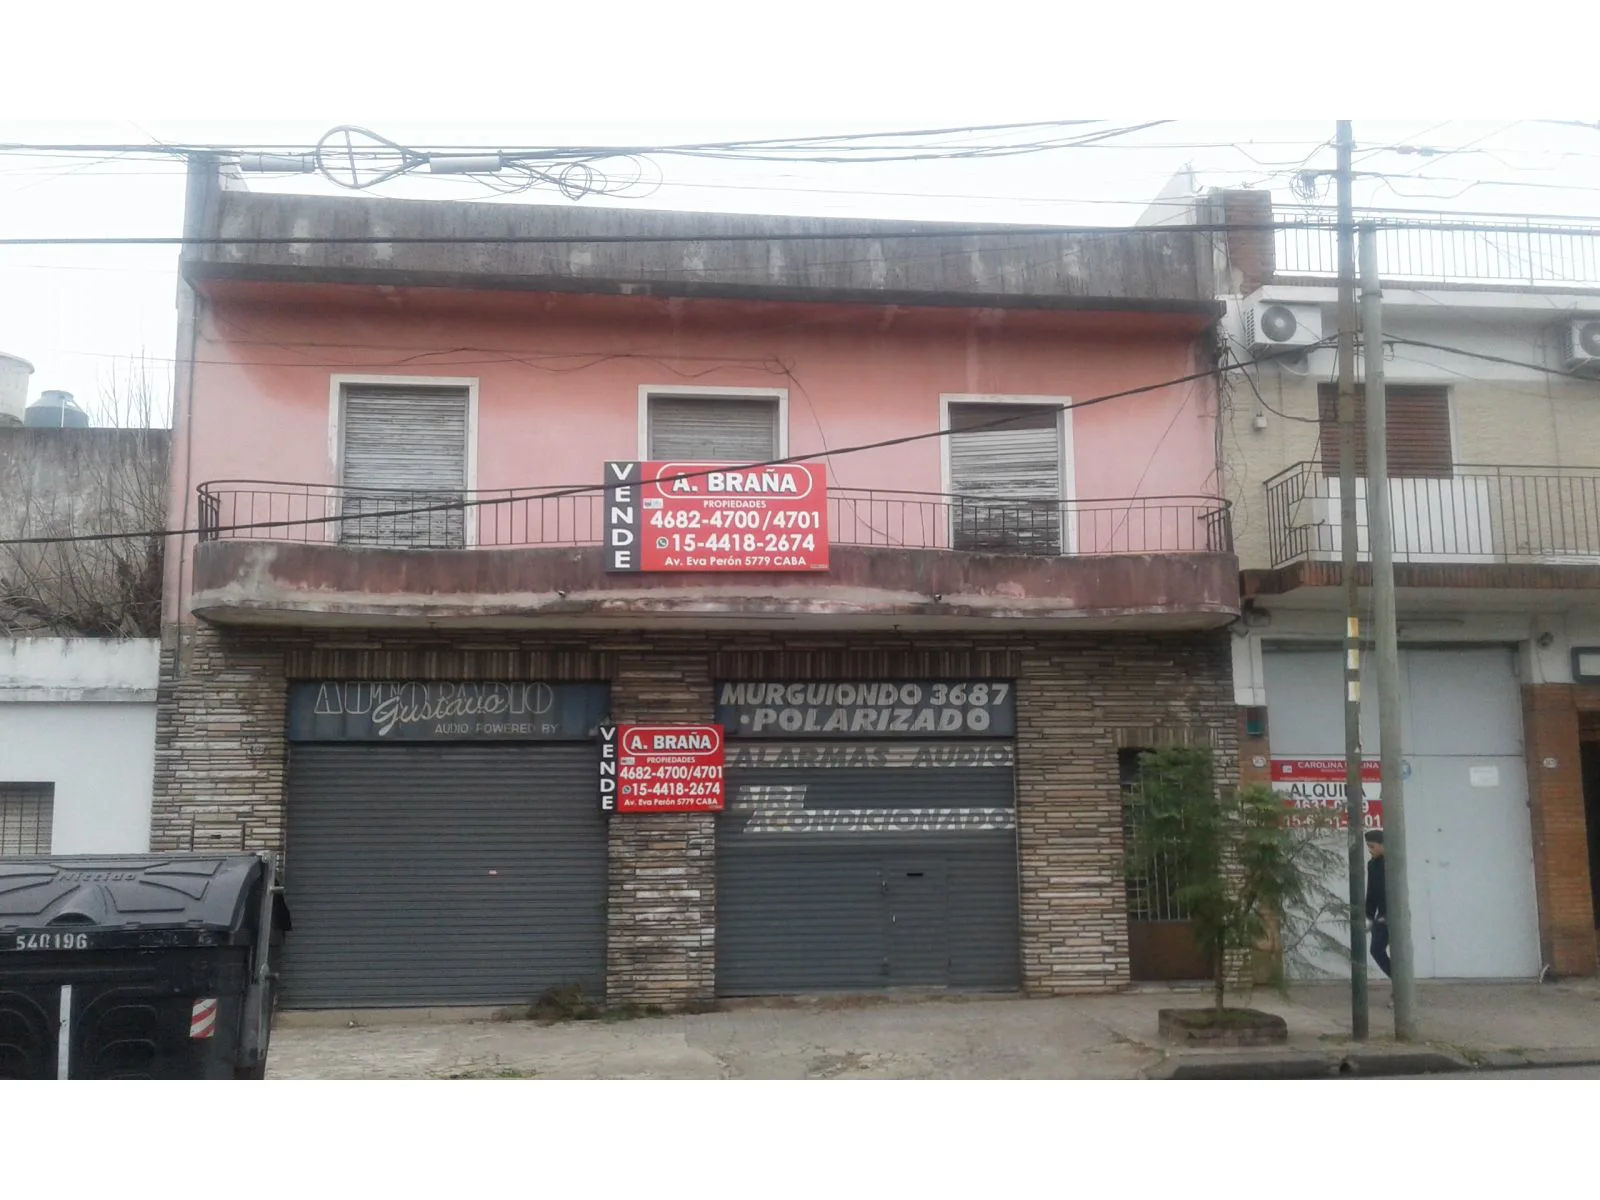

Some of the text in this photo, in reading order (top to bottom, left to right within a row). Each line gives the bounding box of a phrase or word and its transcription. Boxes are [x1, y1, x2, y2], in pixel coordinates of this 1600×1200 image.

[671, 468, 798, 493] A. BRAÑA
[703, 500, 767, 509] PROPIEDADES
[611, 463, 634, 569] VENDE
[672, 533, 816, 552] 15-4418-2674
[665, 556, 806, 567] Av. Eva Perón 5779 CABA
[720, 682, 1010, 706] MURGUIONDO 3687
[435, 722, 469, 734] AUDIO
[541, 722, 560, 733] BY
[630, 731, 712, 750] A. BRAÑA
[646, 756, 696, 764] PROPIEDADES
[1297, 761, 1343, 769] CAROLINA
[600, 726, 616, 810] VENDE
[620, 766, 723, 781] 4682-4700/4701
[632, 782, 721, 796] 15-4418-2674
[1290, 783, 1367, 798] ALQUI
[638, 798, 653, 806] Eva
[654, 797, 676, 806] Perón
[677, 797, 695, 805] 5779
[696, 797, 718, 805] CABA
